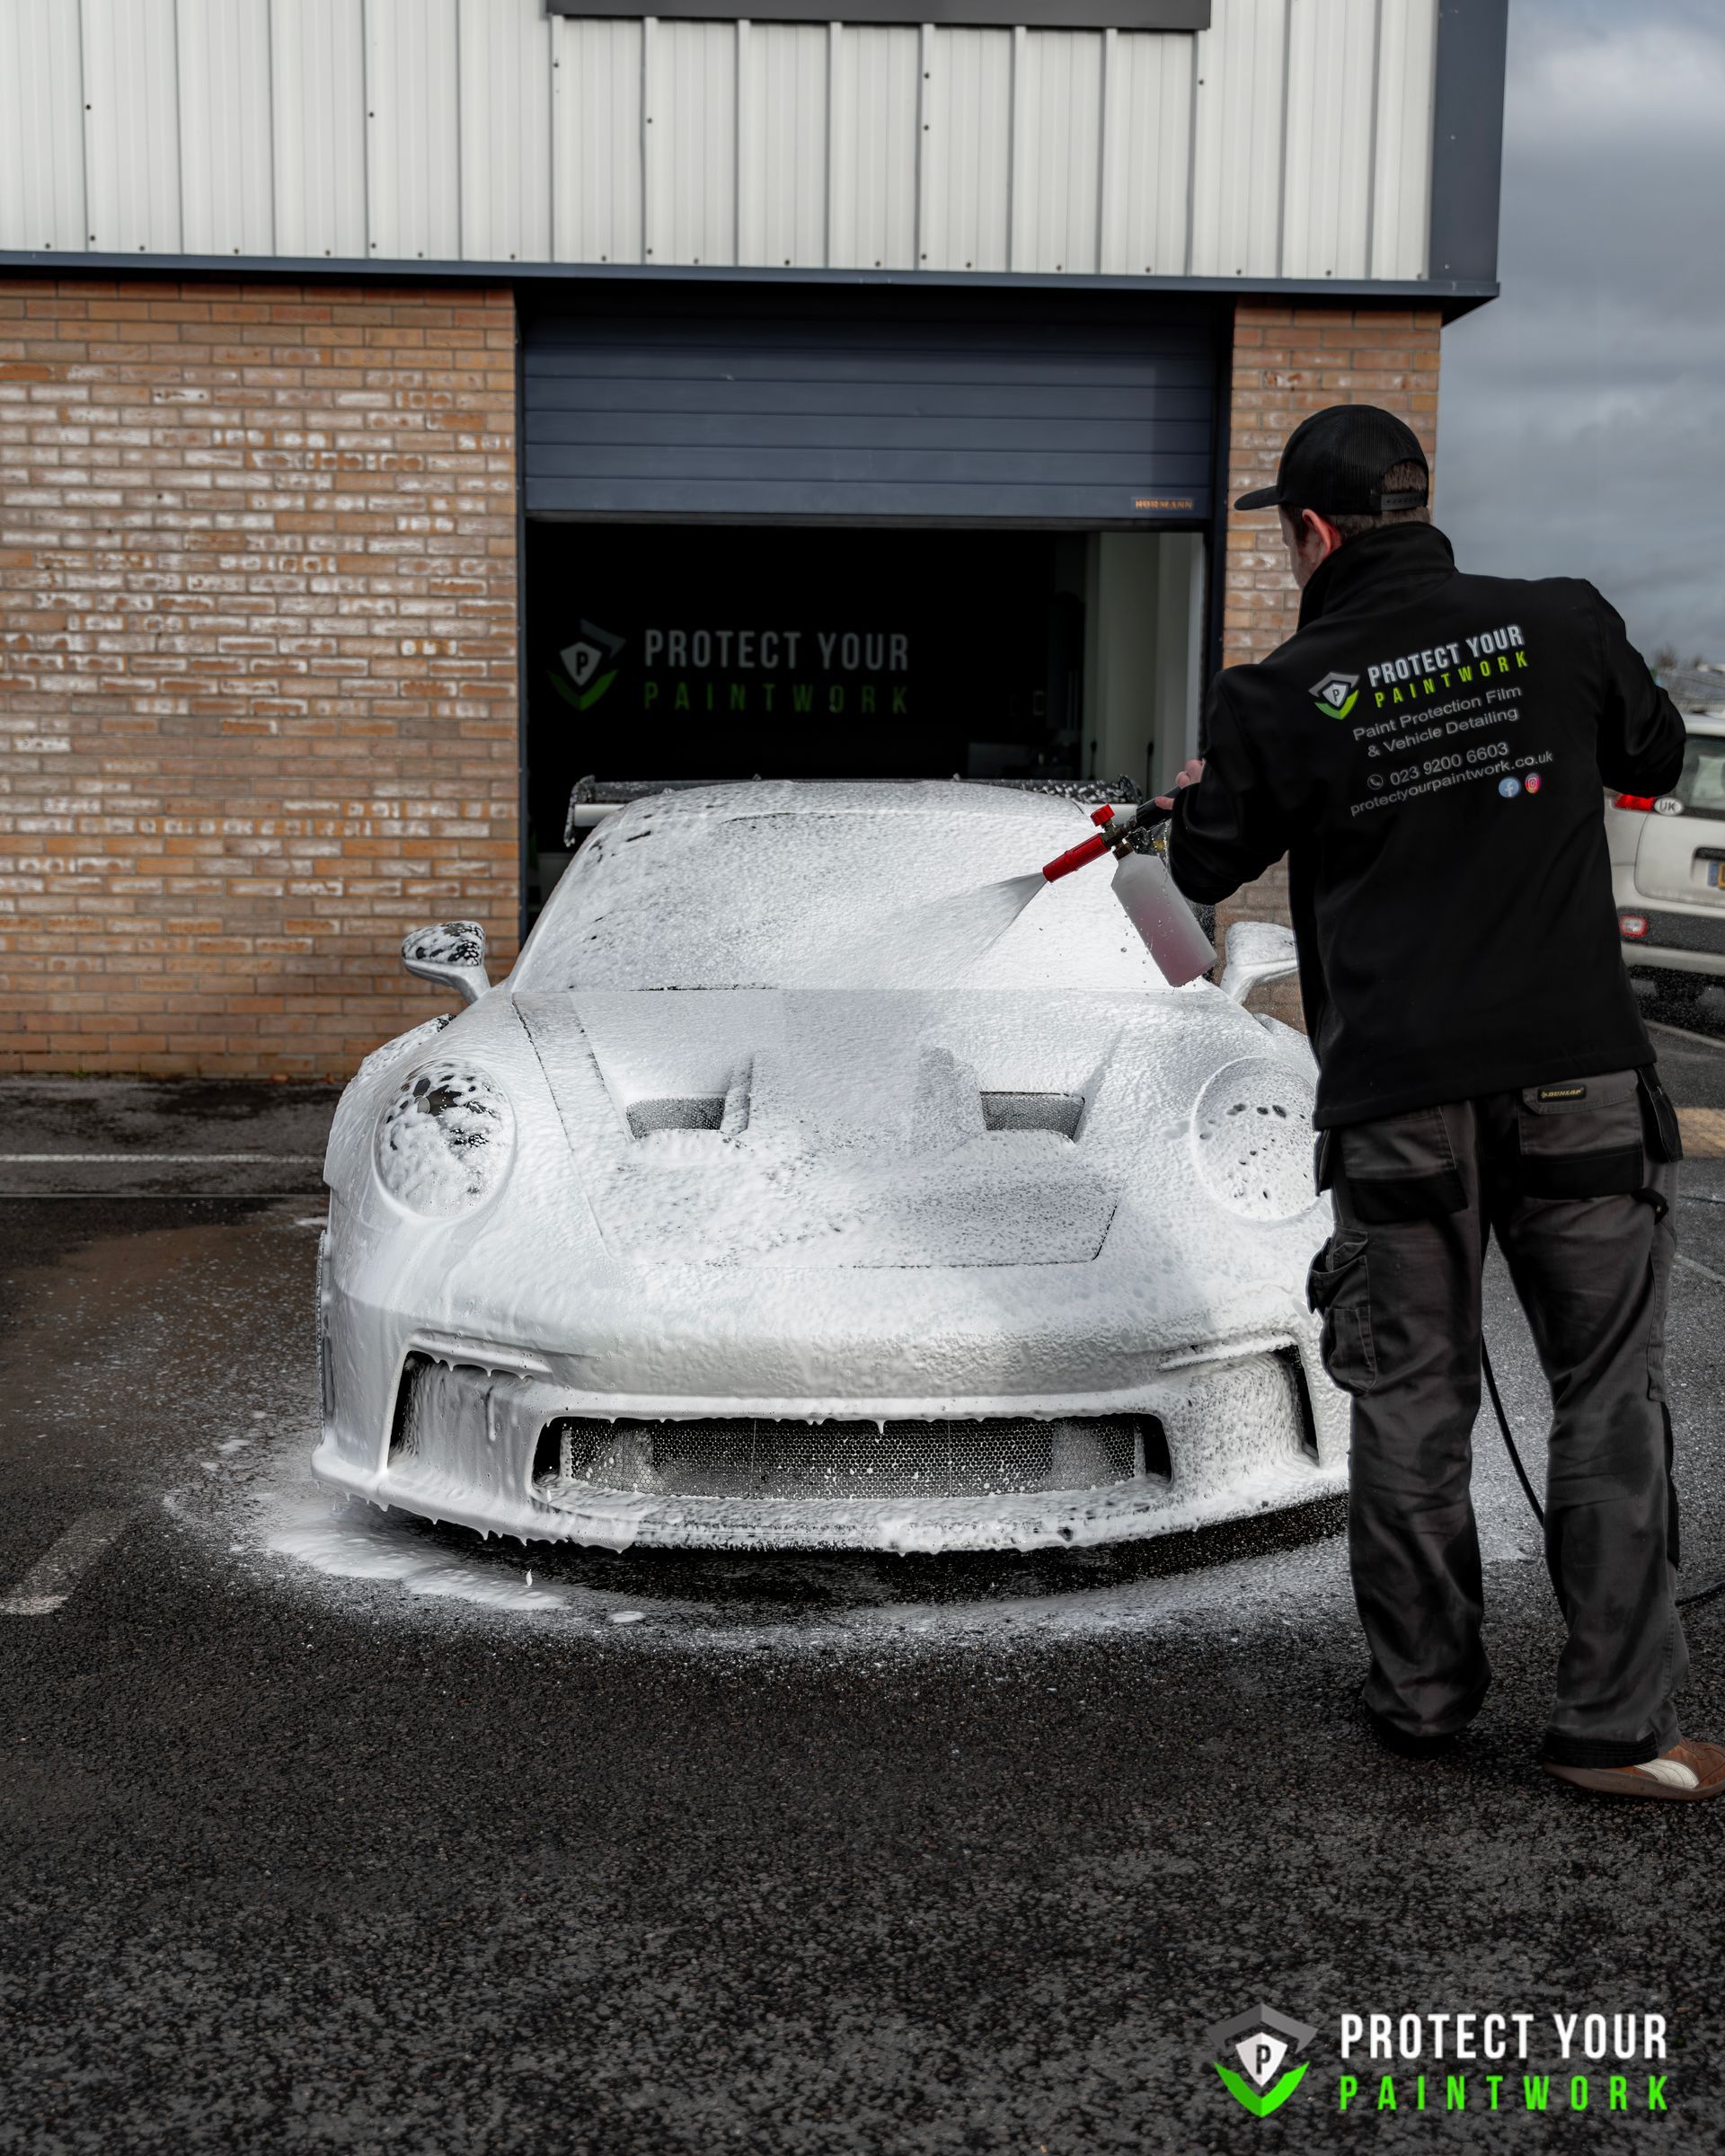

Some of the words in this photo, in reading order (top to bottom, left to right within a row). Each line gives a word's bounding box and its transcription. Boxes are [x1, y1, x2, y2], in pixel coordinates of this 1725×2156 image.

[644, 629, 801, 669] PROTECT
[818, 632, 909, 671] YOUR
[1367, 642, 1460, 688] PROTECT
[1465, 623, 1525, 658] YOUR
[644, 682, 908, 714] PAINTWORK
[1375, 649, 1528, 708] PAINTWORK
[1352, 720, 1397, 741] Paint
[1400, 696, 1482, 729] Protection
[1486, 685, 1522, 705] Film
[1367, 745, 1380, 757] &
[1383, 726, 1442, 753] Vehicle
[1446, 707, 1519, 735] Detailing
[1350, 750, 1553, 817] protectyourpaintwork.co.uk
[1390, 767, 1420, 786] 023
[1423, 754, 1462, 776] 9200
[1466, 741, 1509, 764] 6603
